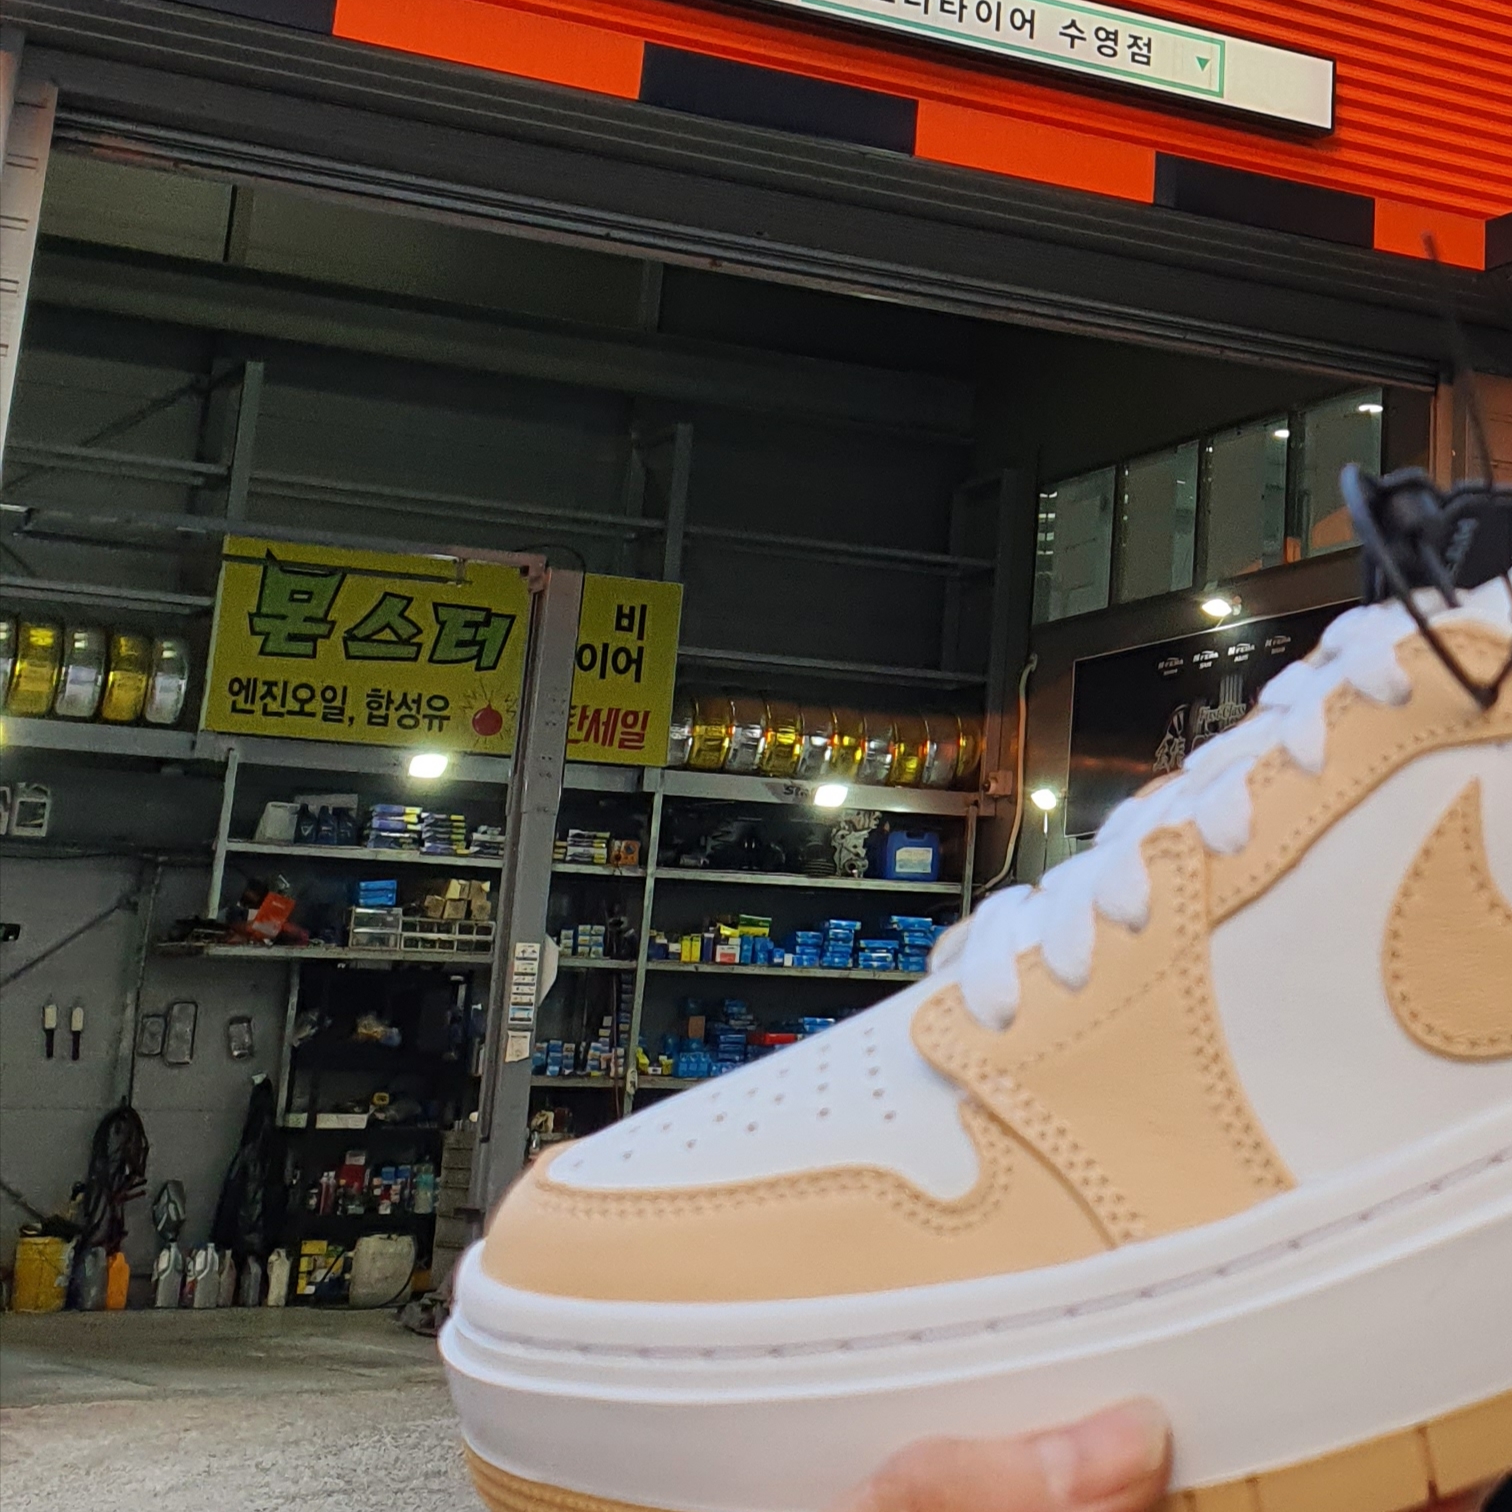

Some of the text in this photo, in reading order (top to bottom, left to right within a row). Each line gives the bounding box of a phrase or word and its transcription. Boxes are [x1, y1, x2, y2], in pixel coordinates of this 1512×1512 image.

[1058, 18, 1152, 67] 수영점
[248, 548, 517, 672] 몬스터
[228, 677, 451, 732] 엔진오일, 합성유
